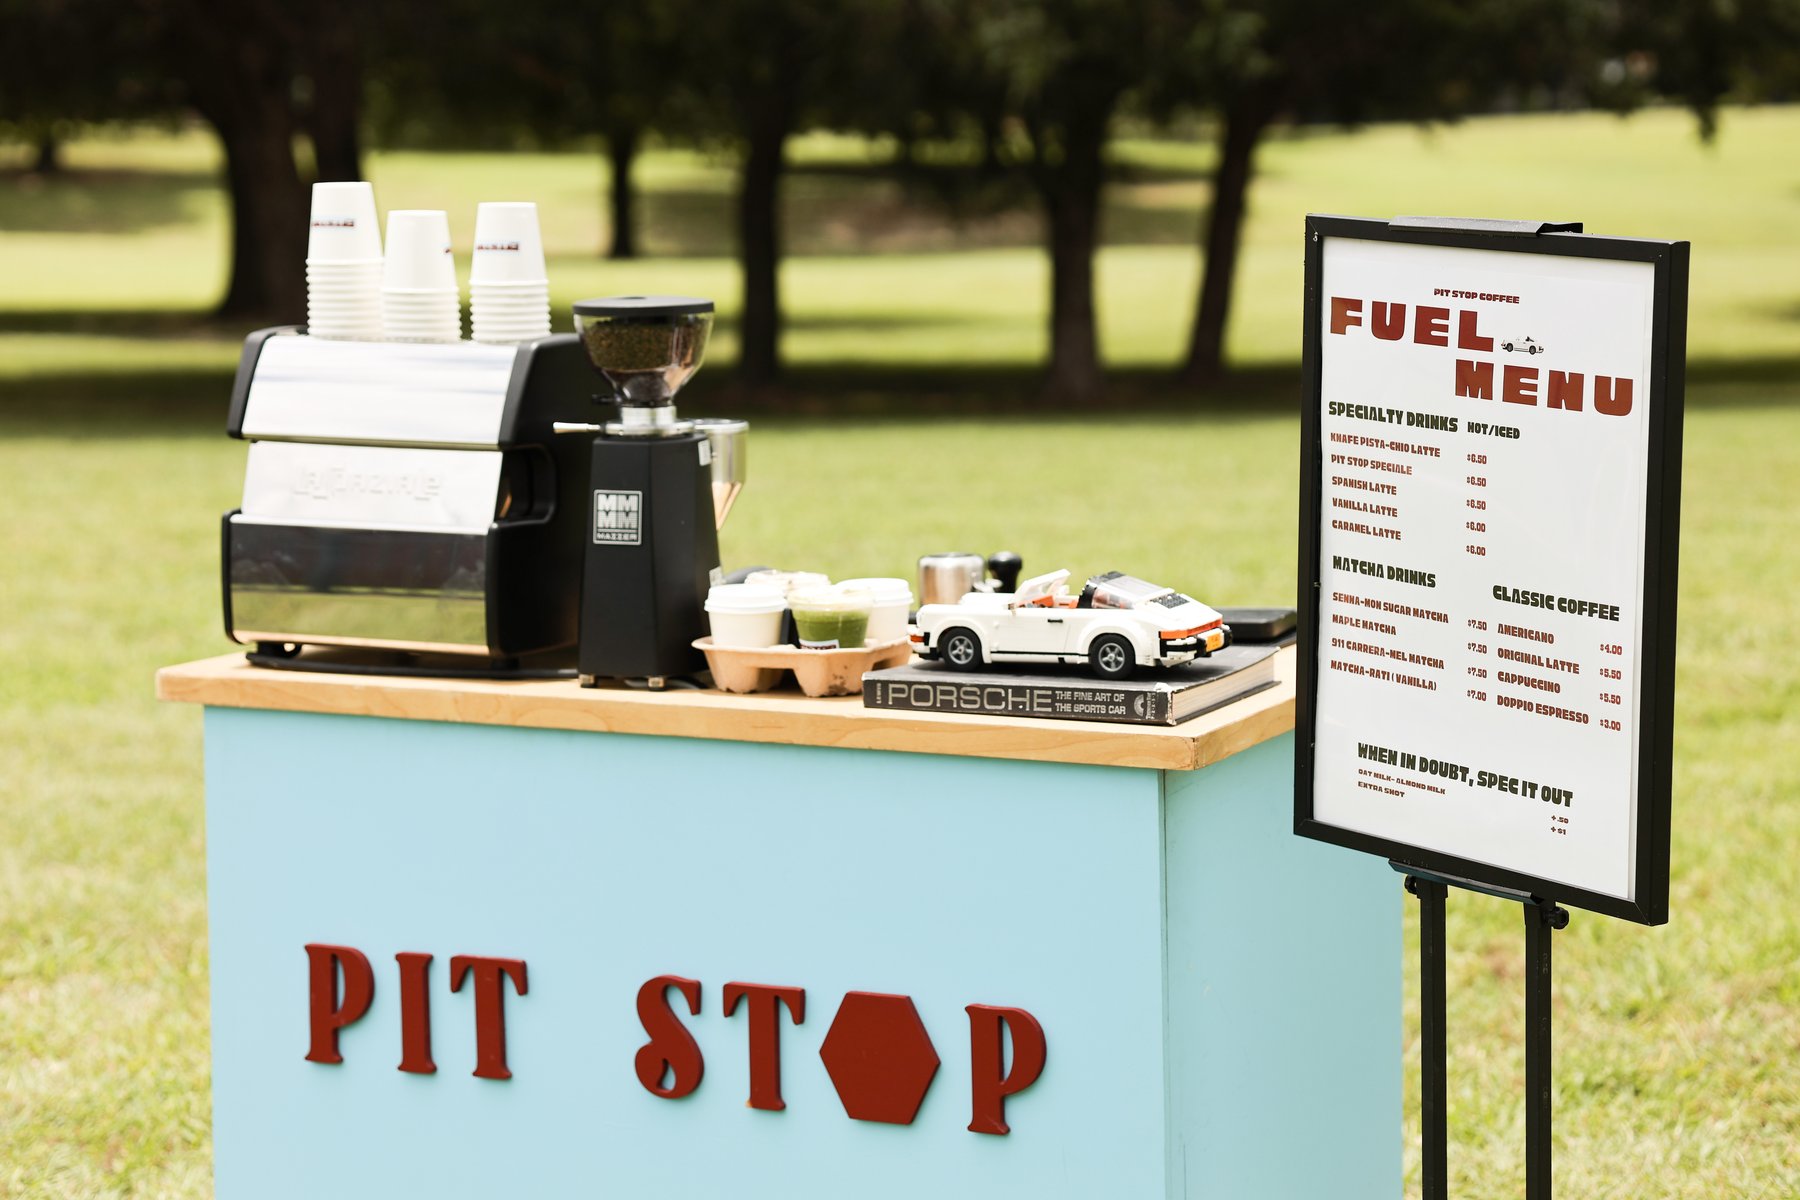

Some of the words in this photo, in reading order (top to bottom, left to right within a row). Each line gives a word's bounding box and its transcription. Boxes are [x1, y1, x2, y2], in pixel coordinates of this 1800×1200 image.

[1434, 288, 1450, 297] PIT
[1452, 290, 1478, 300] STOP
[1479, 293, 1520, 304] COFFEE
[1330, 296, 1494, 352] FUEL
[1455, 359, 1633, 416] MENU
[1329, 401, 1404, 425] SPECIALTY
[1406, 412, 1458, 432] DRINKS
[1467, 421, 1520, 439] HOT/ICED
[1331, 432, 1359, 445] KNAFE
[1360, 436, 1410, 453] PISTA-CHIO
[1411, 444, 1440, 458] LATTE
[1331, 454, 1345, 465] PIT
[1347, 456, 1369, 468] STOP
[1370, 460, 1412, 476] SPECIALE
[1467, 454, 1487, 464] $6.50
[1332, 476, 1368, 491] SPANISH
[1369, 482, 1397, 495] LATTE
[1467, 476, 1487, 487] $6.50
[1332, 497, 1368, 512] VANILLA
[1370, 504, 1398, 517] LATTE
[1466, 499, 1486, 510] $6.50
[1332, 520, 1371, 535] CARAMEL
[1373, 526, 1401, 540] LATTE
[1332, 555, 1384, 578] MATCHA
[1387, 565, 1436, 588] DRINKS
[1332, 592, 1381, 610] SENNA-MON
[1383, 602, 1411, 616] SUGAR
[1412, 607, 1448, 623] MATCHA
[1493, 584, 1554, 610] CLASSIC
[1557, 597, 1619, 622] COFFEE
[1332, 614, 1361, 627] MAPLE
[1362, 620, 1396, 636] MATCHA
[1468, 619, 1487, 631] $7.50
[1498, 623, 1554, 644] AMERICANO
[1332, 637, 1344, 648] 911
[1346, 640, 1407, 662] CARRERA-MEL
[1409, 654, 1444, 670] MATCHA
[1468, 643, 1487, 654] $7.50
[1600, 644, 1622, 655] $4.00
[1331, 660, 1390, 681] MATCHA-RATI
[1498, 647, 1544, 667] ORIGINAL
[1546, 658, 1580, 675] LATTE
[1468, 667, 1487, 678] $7.50
[1498, 671, 1561, 694] CAPPUCCINO
[1600, 668, 1621, 680] $5.50
[888, 683, 1052, 712] PORSCHE
[1055, 691, 1071, 700] THE
[1074, 692, 1092, 700] FINE
[1095, 692, 1111, 702] ART
[1113, 694, 1124, 702] OF
[1467, 690, 1487, 701] $7.00
[1600, 693, 1621, 705] $5.50
[1055, 703, 1071, 712] THE
[1073, 704, 1106, 713] SPORTS
[1108, 706, 1126, 714] CAR
[1497, 695, 1534, 712] DOPPIO
[1535, 703, 1589, 724] ESPRESSO
[1600, 719, 1621, 731] $3.00
[1358, 742, 1398, 766] WHEN
[1400, 752, 1416, 770] IN
[1419, 756, 1474, 787] DOUBT,
[1477, 770, 1518, 795] SPEC
[1521, 780, 1538, 799] IT
[1541, 785, 1573, 808] OUT
[1358, 781, 1382, 792] EXTRA
[1384, 788, 1405, 797] SHOT
[1396, 778, 1426, 790] ALMOND
[1427, 785, 1445, 794] MILK
[304, 943, 528, 1080] PIT
